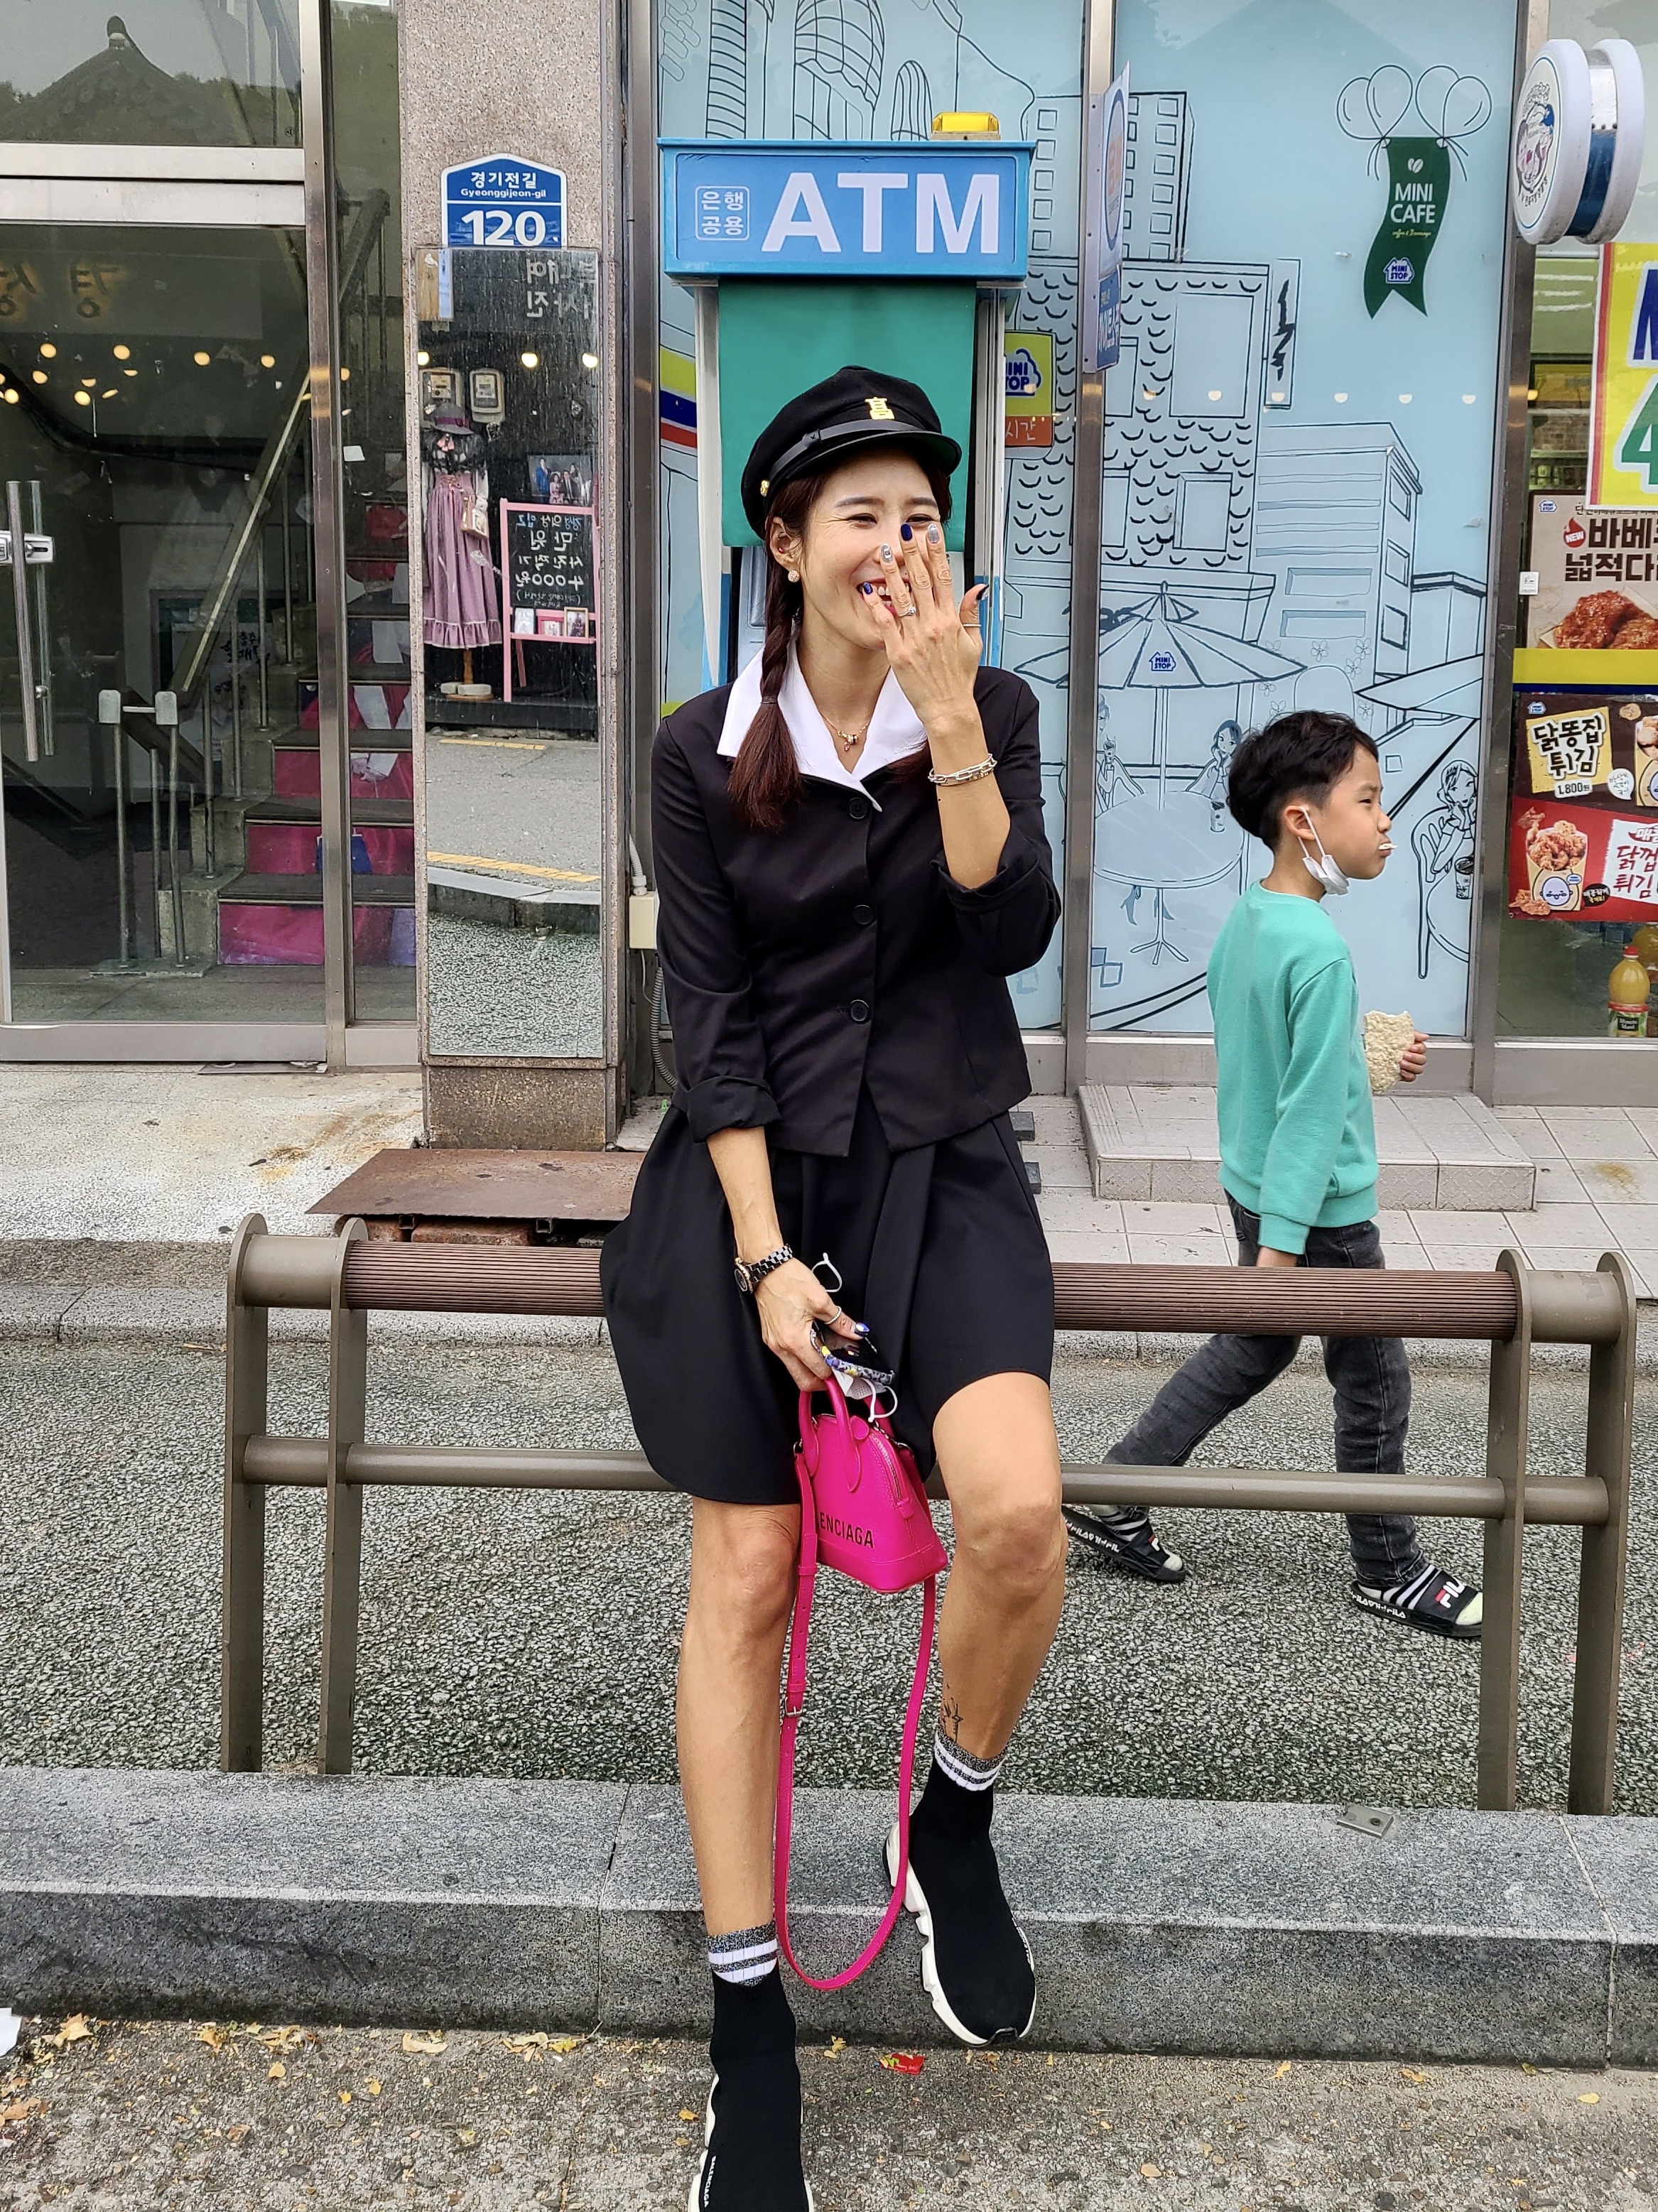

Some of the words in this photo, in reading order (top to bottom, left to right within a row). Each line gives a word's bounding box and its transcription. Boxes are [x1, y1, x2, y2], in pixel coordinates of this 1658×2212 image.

[470, 171, 537, 189] 경기전길
[460, 188, 546, 199] Gyeonggijeon-gil
[700, 189, 744, 212] 은행
[1394, 183, 1434, 202] MINI
[761, 172, 1000, 254] ATM
[1390, 204, 1436, 224] CAFE
[461, 210, 546, 246] 120
[700, 215, 744, 236] 공용
[1006, 362, 1029, 376] INI
[1006, 376, 1030, 391] TOP
[1565, 531, 1584, 543] NEW
[1565, 553, 1658, 582] 넓적다
[1533, 715, 1603, 753] 닭똥집
[1550, 746, 1595, 776] 튀김
[1613, 874, 1654, 899] 튀김
[817, 1511, 875, 1549] ENCIAGA
